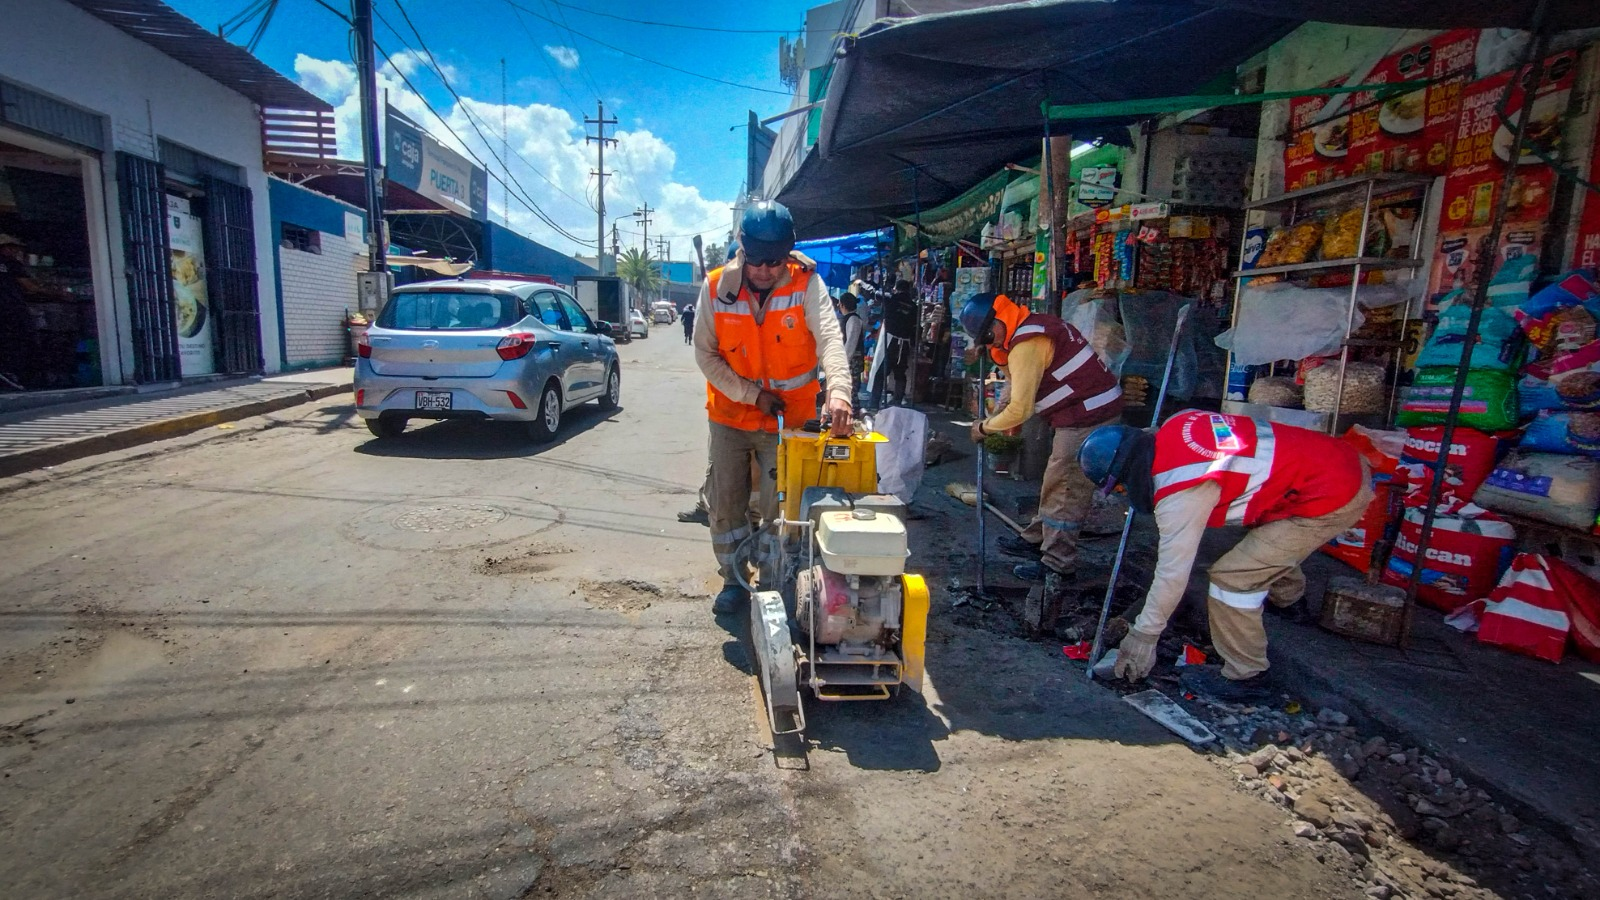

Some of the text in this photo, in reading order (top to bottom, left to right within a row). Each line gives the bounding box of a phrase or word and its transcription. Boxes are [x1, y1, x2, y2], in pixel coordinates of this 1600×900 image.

[1463, 86, 1506, 111] HAGAMOS
[1460, 110, 1470, 125] EL
[1458, 117, 1492, 139] DE CASA
[429, 168, 459, 196] PUERTA
[460, 184, 465, 200] 3
[1581, 250, 1596, 265] EL
[417, 396, 450, 408] VBH-532
